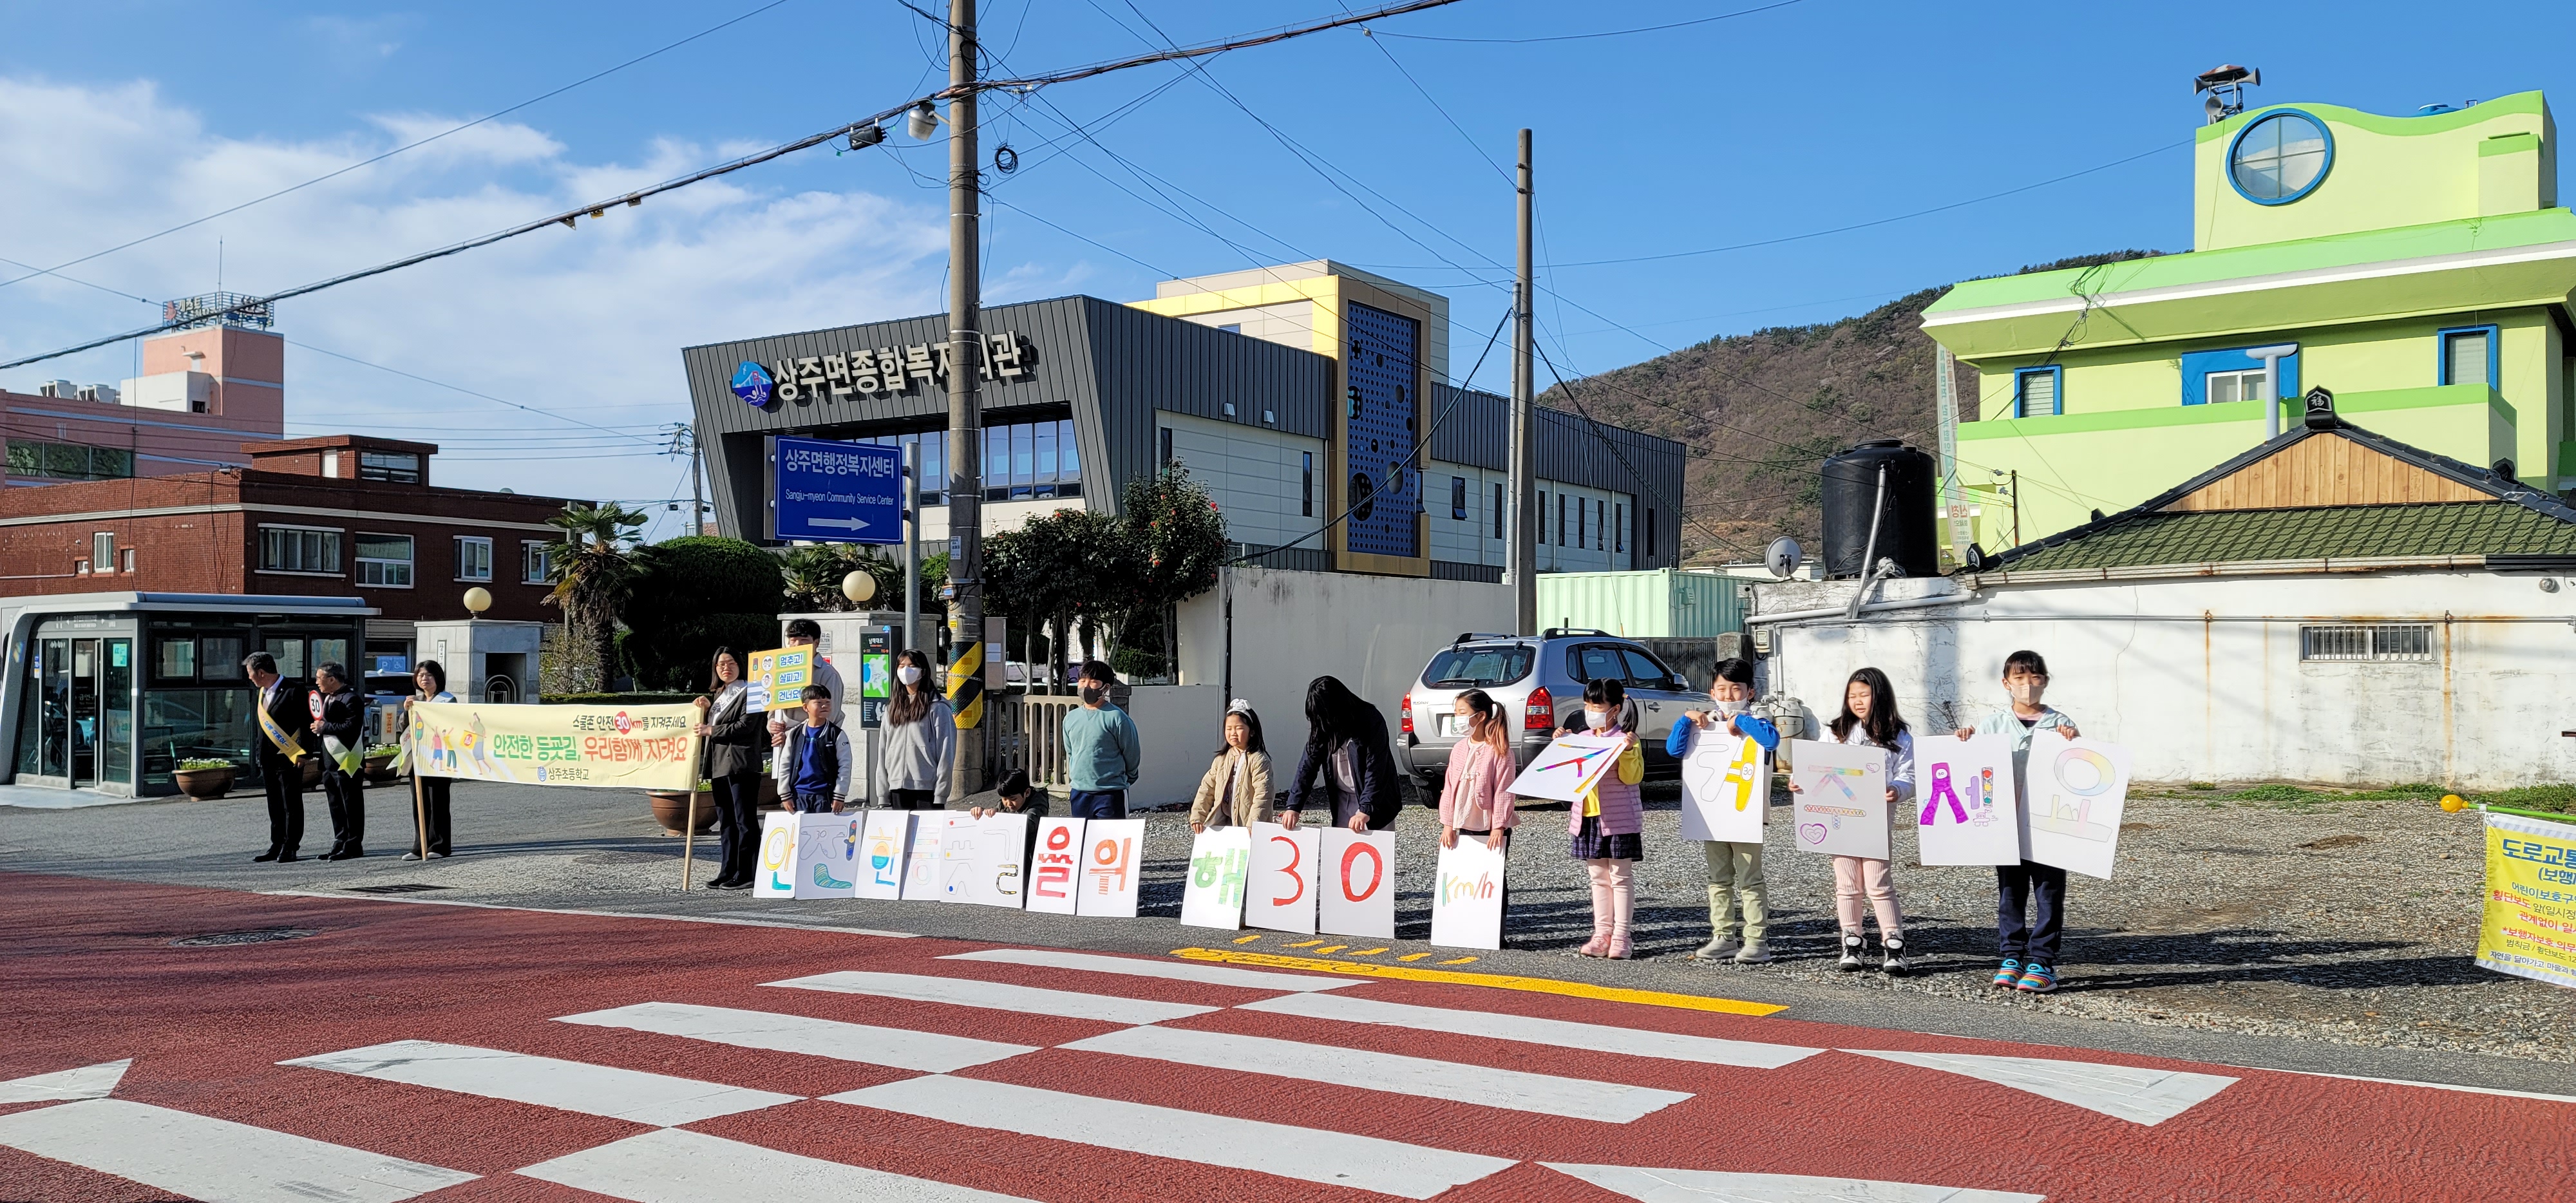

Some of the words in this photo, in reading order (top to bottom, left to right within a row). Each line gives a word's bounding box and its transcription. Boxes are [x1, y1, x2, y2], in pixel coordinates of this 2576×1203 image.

[775, 330, 1022, 401] 상주면종합복관
[784, 448, 895, 479] 상주면행정복지센터
[786, 488, 826, 502] Sangju-myeon
[826, 491, 855, 505] Community
[857, 493, 876, 505] Service
[877, 495, 894, 506] Center
[780, 654, 803, 666] 멈추고!
[311, 699, 320, 712] 30
[573, 714, 595, 731] 스쿨존
[596, 715, 616, 731] 안전
[650, 715, 687, 730] 지켜주세요
[493, 734, 534, 760] 안전한
[584, 737, 643, 762] 우리함께
[644, 737, 688, 763] 지켜요
[548, 766, 589, 781] 상주초등학교
[2503, 838, 2576, 870] 도로교통
[2539, 867, 2576, 886] (보행
[2492, 889, 2532, 909] 횡단보도
[2512, 882, 2576, 904] 어린이보호구
[2519, 910, 2558, 931] 관계없이
[2506, 939, 2530, 951] 범칙금
[2537, 946, 2567, 960] 횡단보도
[2490, 951, 2512, 961] 자연을
[2546, 962, 2568, 974] 마을과
